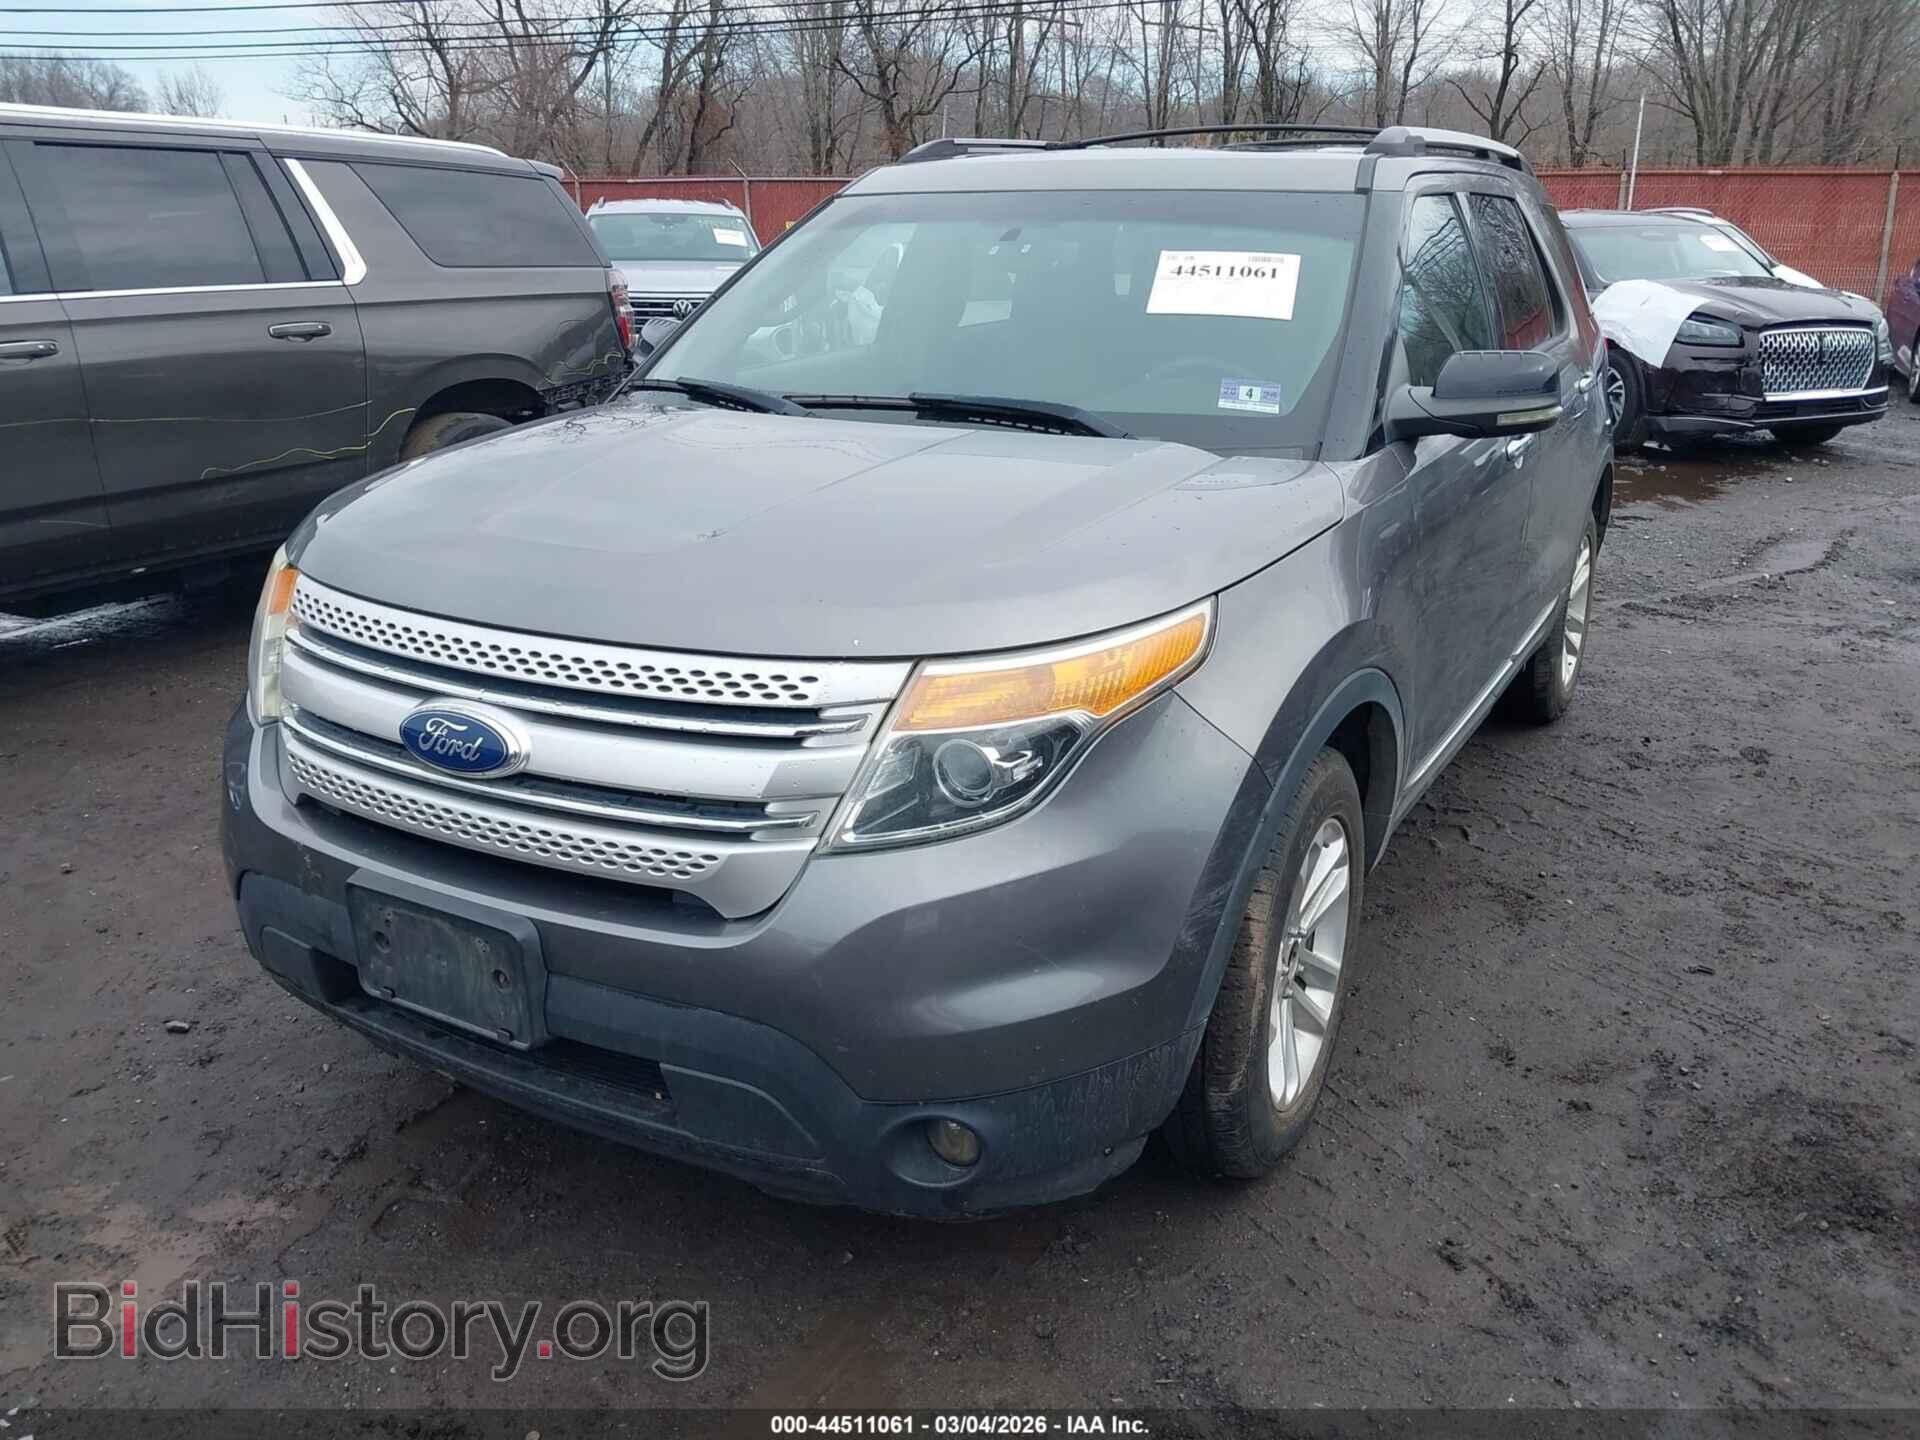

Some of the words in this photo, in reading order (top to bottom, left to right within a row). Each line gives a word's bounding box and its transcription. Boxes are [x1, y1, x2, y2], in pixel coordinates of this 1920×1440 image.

[1169, 265, 1278, 280] 44511061
[1245, 387, 1254, 400] 4
[418, 717, 484, 762] Ford
